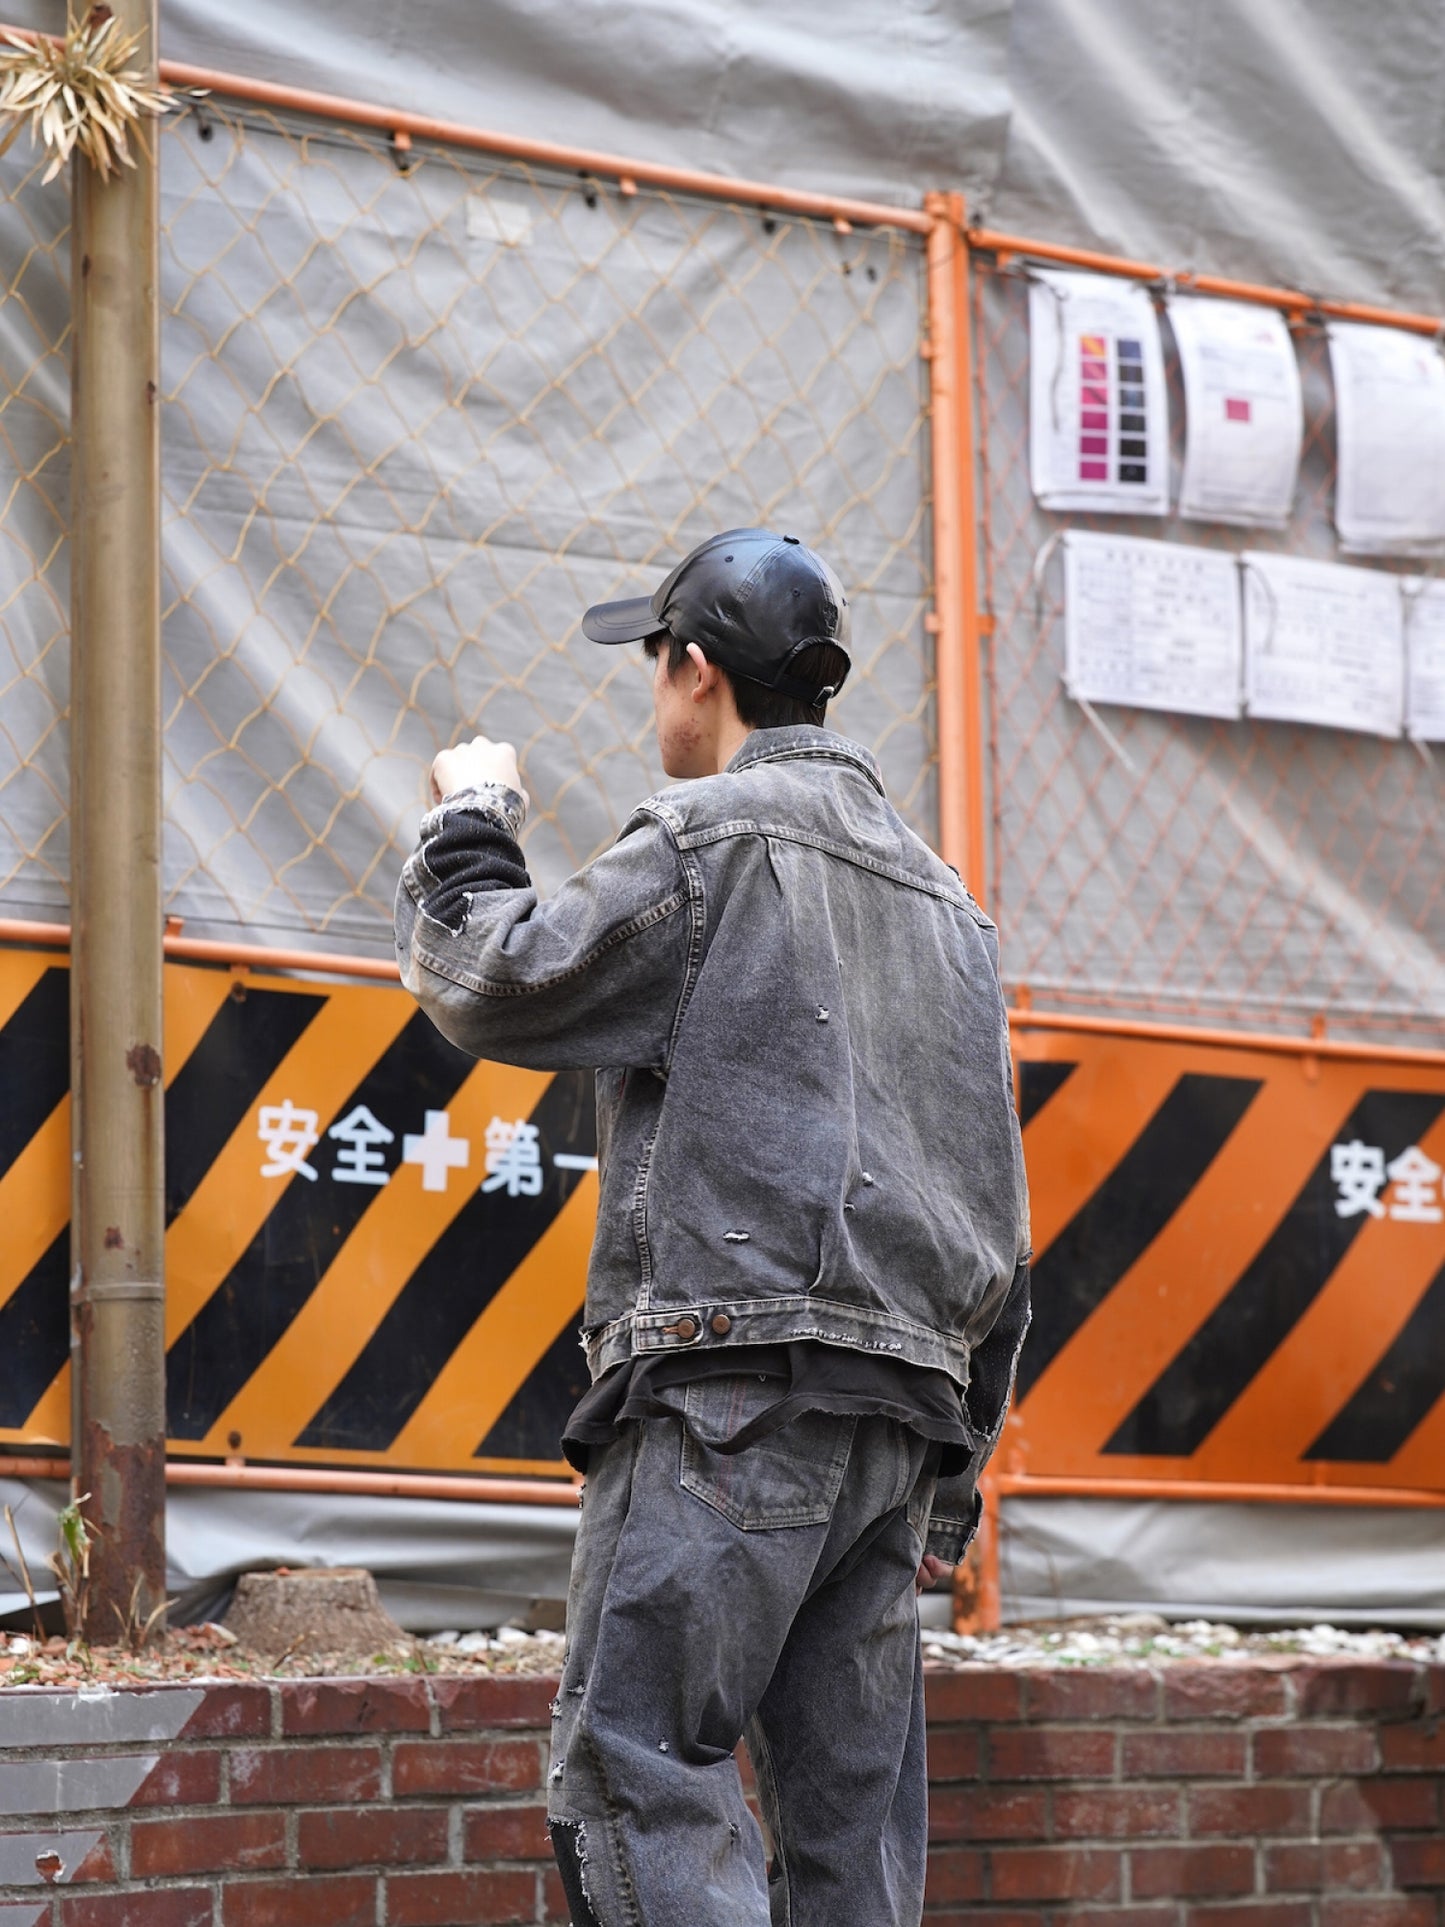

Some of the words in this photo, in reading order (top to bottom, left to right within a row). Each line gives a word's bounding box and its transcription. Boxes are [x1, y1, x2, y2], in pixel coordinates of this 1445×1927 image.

[258, 1099, 395, 1186] 安全
[481, 1116, 599, 1197] 第一
[1330, 1139, 1443, 1223] 安全
